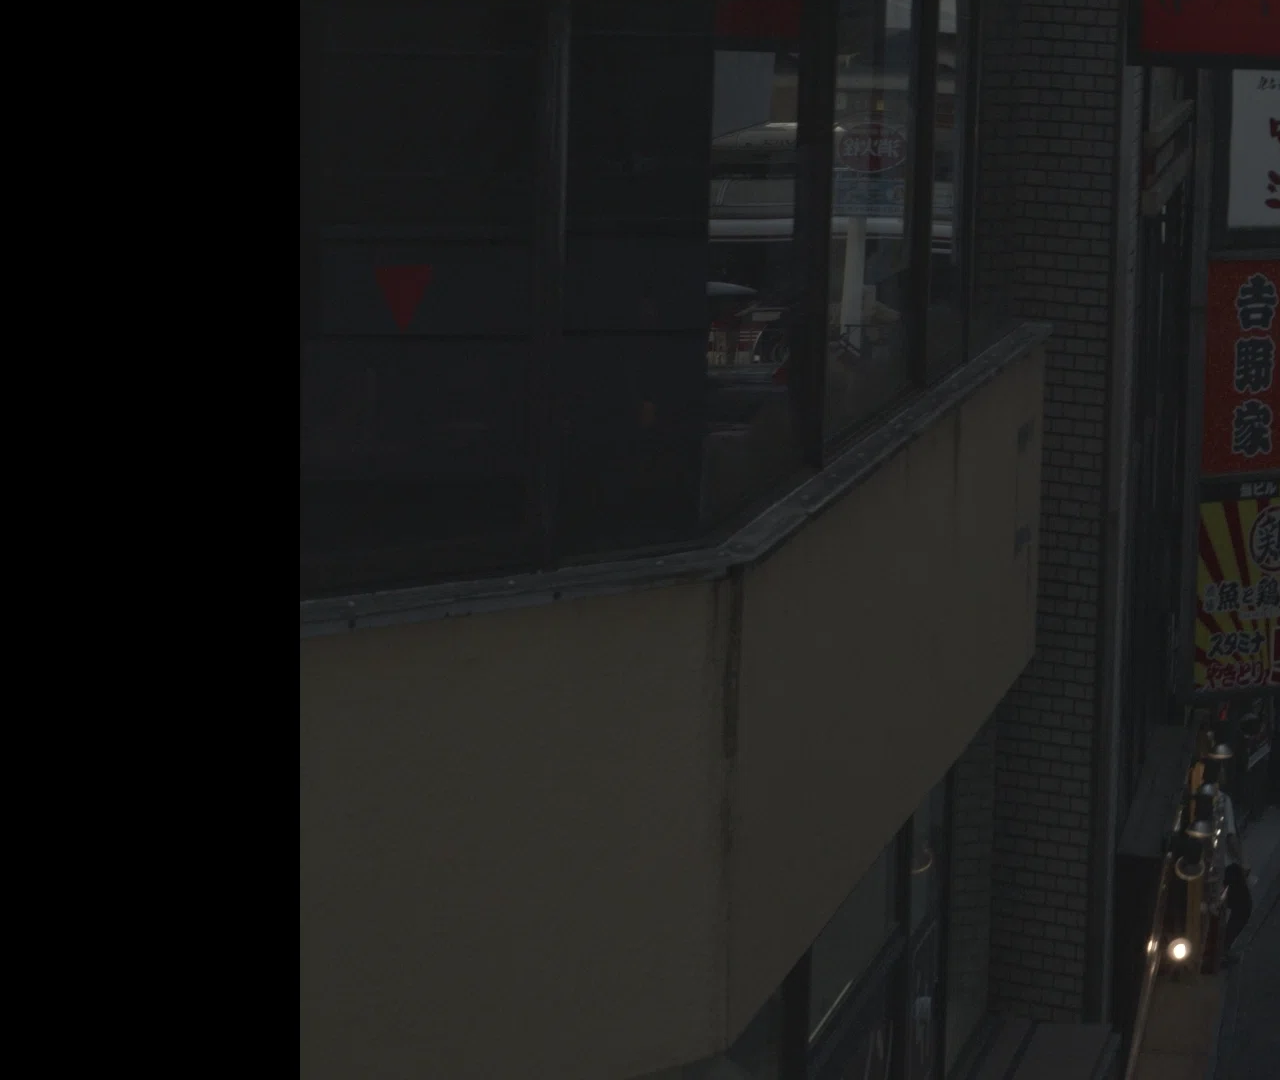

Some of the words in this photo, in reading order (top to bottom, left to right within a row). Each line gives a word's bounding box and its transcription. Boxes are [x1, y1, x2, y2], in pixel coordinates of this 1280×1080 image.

[1234, 273, 1278, 457] 吉野家
[1208, 632, 1266, 657] スタミナ
